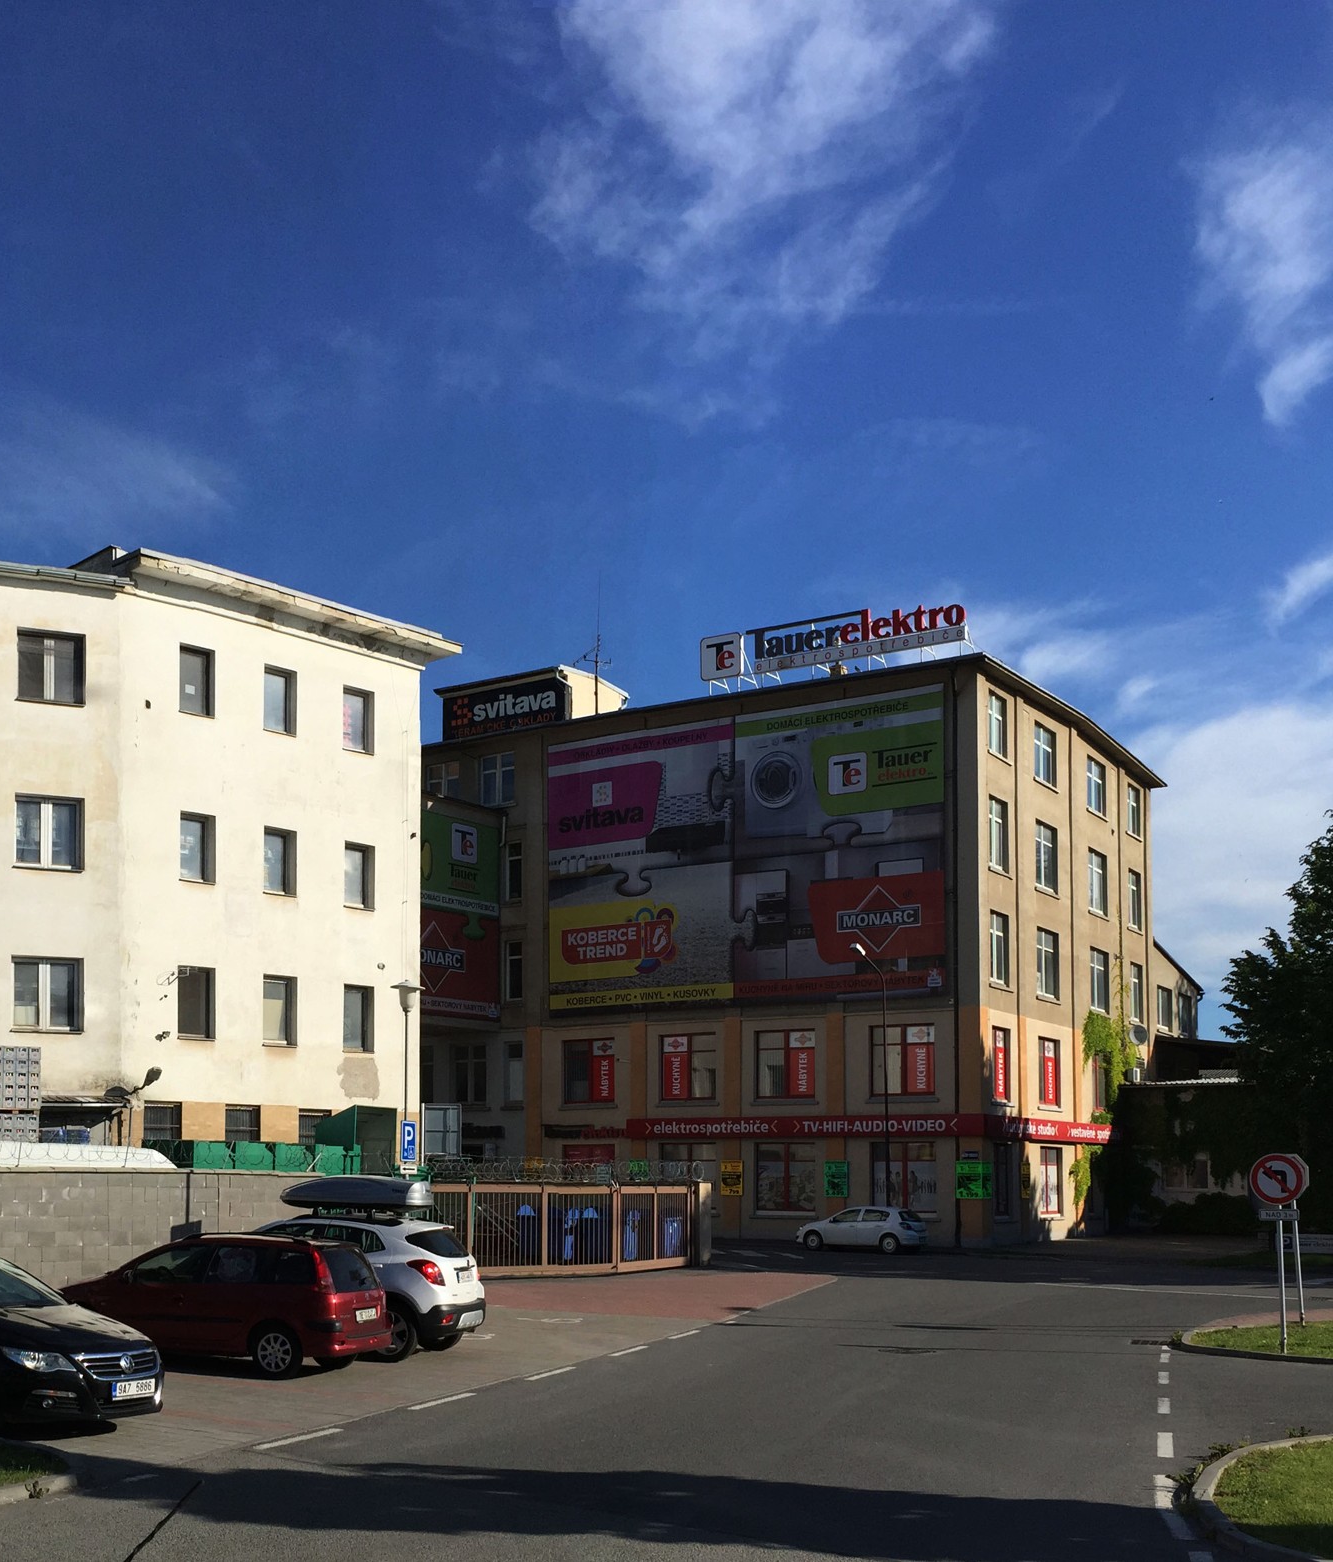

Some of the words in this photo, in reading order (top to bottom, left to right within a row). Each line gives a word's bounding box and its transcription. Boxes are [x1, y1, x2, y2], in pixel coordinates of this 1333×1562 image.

[473, 690, 557, 721] svitava
[766, 716, 803, 731] DOMÁCÍ
[805, 701, 909, 726] ELEKTROSPOTŘEBIČE
[662, 732, 708, 746] KOUPELNY
[834, 759, 861, 787] Te
[872, 743, 937, 768] Tauer
[877, 766, 926, 782] elektro
[558, 806, 644, 833] svitava
[842, 909, 915, 928] MONARC
[567, 926, 637, 946] KOBERCE
[421, 949, 461, 968] ONARC
[577, 943, 627, 960] TREND
[566, 996, 607, 1006] KOBERCE
[614, 993, 632, 1003] PVC
[639, 990, 665, 1000] VINYL
[673, 988, 716, 999] KUSOVKY
[600, 1059, 609, 1097] NÁBYTEK
[797, 1052, 807, 1092] NÁBYTEK
[653, 1119, 769, 1136] elektrospotřebiče
[802, 1119, 946, 1133] TV-HIFI-AUDIO-VIDEO
[1037, 1122, 1055, 1136] studio
[404, 1126, 414, 1149] P
[118, 1382, 132, 1395] 9A7
